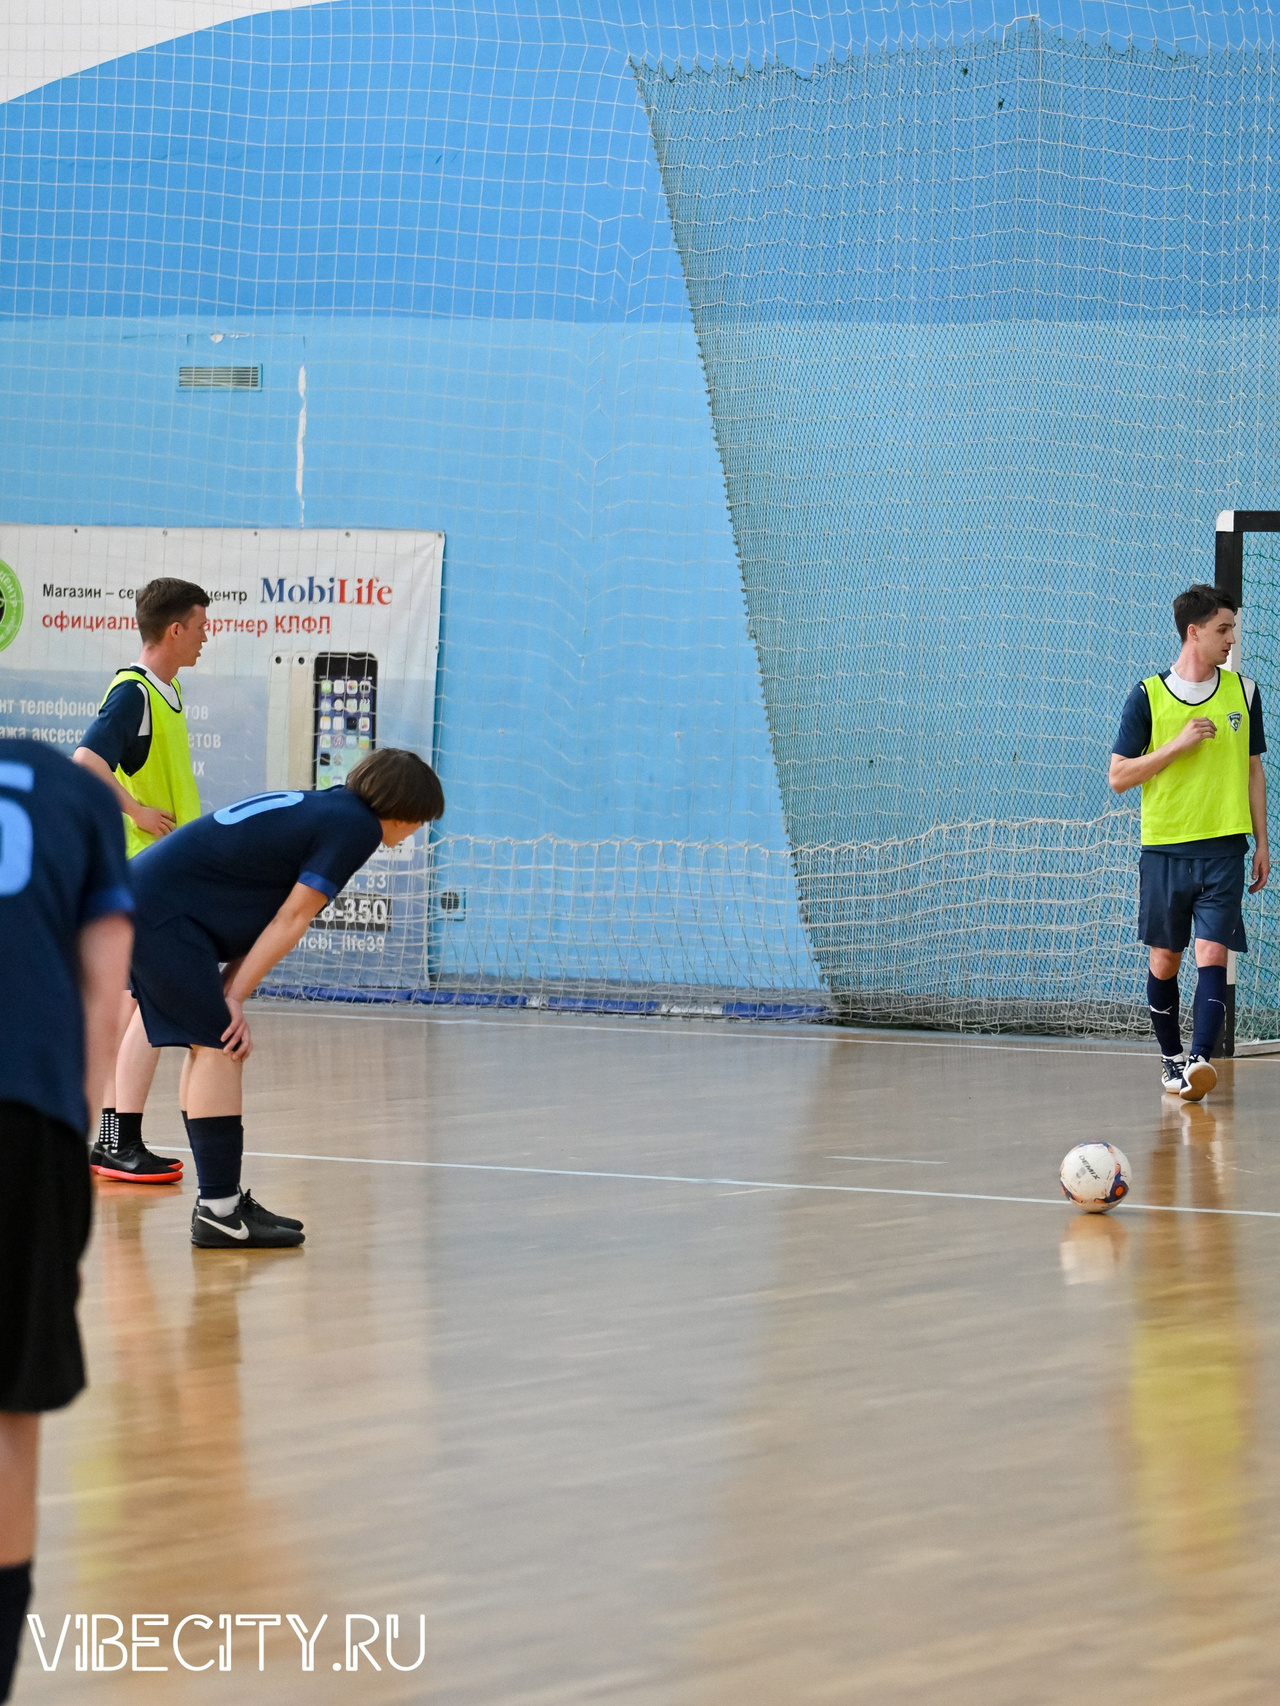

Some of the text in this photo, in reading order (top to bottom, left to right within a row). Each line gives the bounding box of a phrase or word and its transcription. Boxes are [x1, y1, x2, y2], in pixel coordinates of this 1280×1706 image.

[43, 583, 102, 599] Магазин
[206, 589, 248, 605] центр
[259, 576, 393, 606] MobiLife
[42, 610, 139, 632] официаль
[203, 616, 268, 638] артнер
[275, 615, 332, 635] КЛФЛ
[1079, 1154, 1101, 1181] DEMIX
